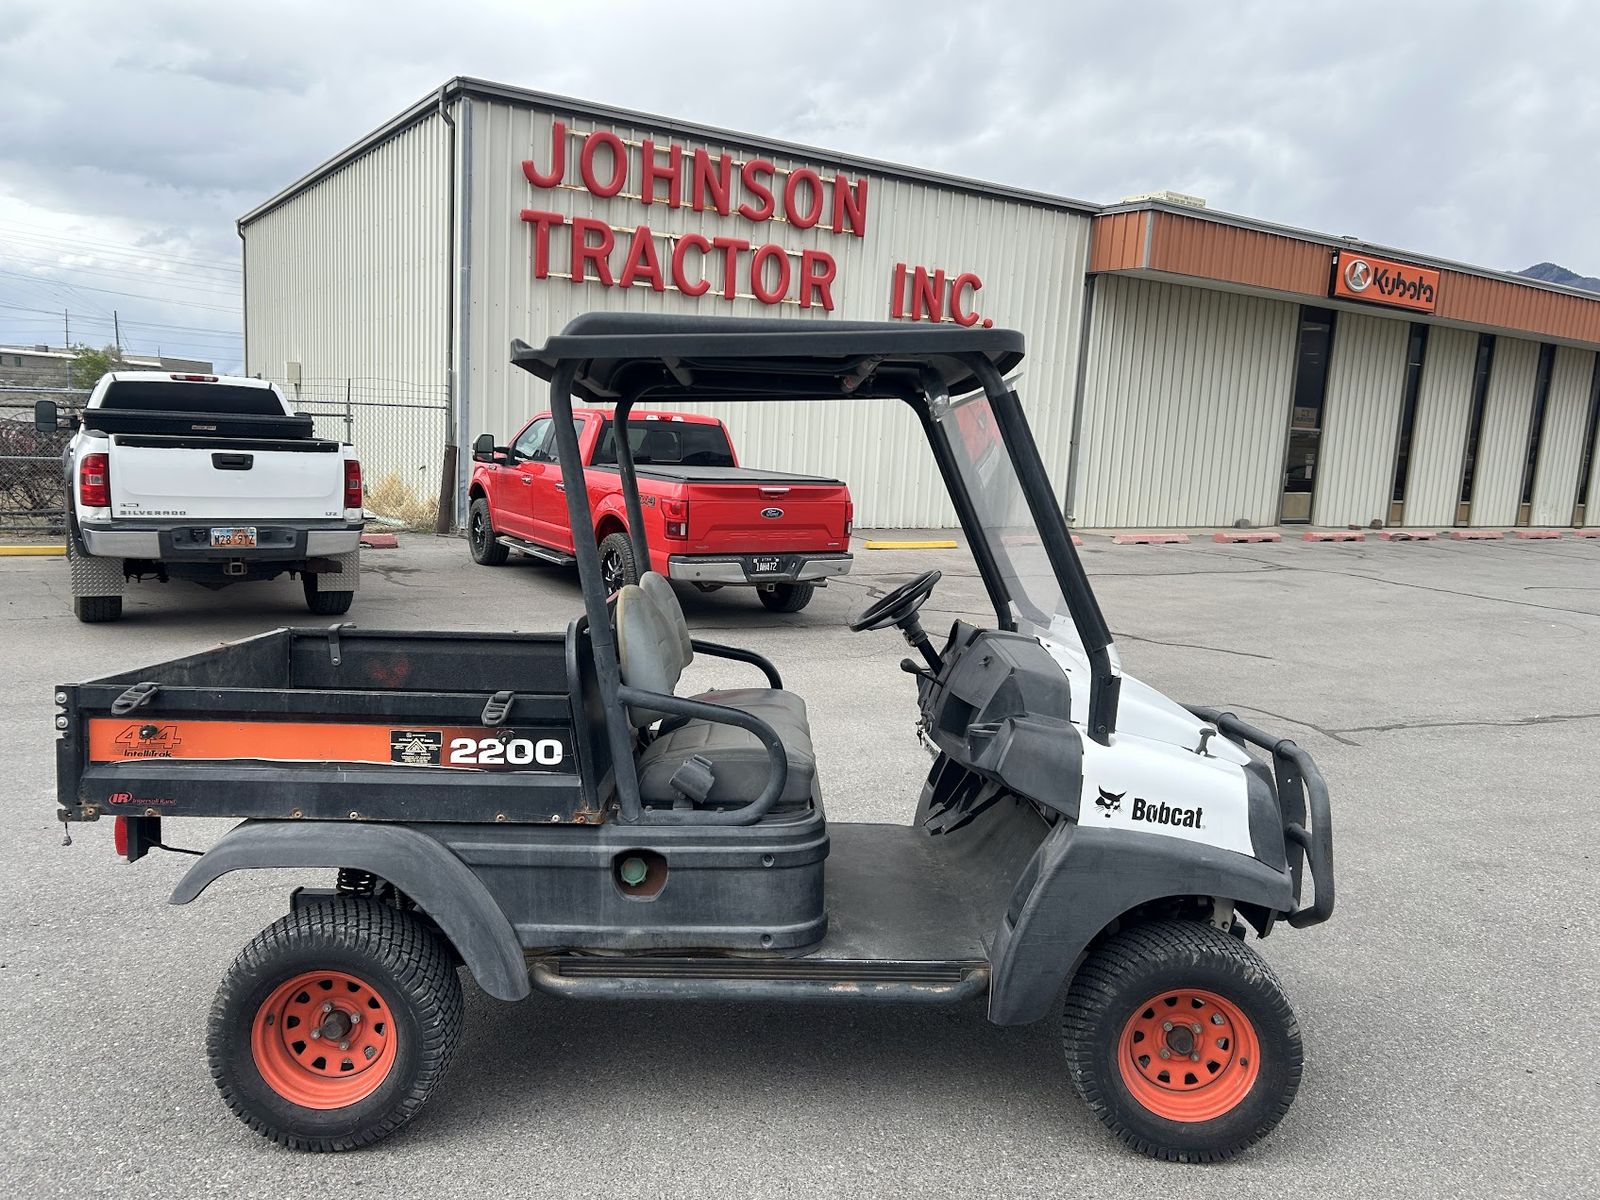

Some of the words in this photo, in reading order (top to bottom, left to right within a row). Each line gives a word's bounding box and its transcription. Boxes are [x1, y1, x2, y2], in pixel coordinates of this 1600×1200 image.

[522, 121, 868, 237] JOHNSON
[520, 209, 837, 311] TRACTOR
[892, 263, 993, 328] INC.
[1373, 267, 1434, 303] Kubota
[124, 749, 172, 758] IntelliTrak
[450, 738, 563, 765] 2200
[112, 793, 130, 804] IR
[1132, 797, 1203, 829] Bobcat
